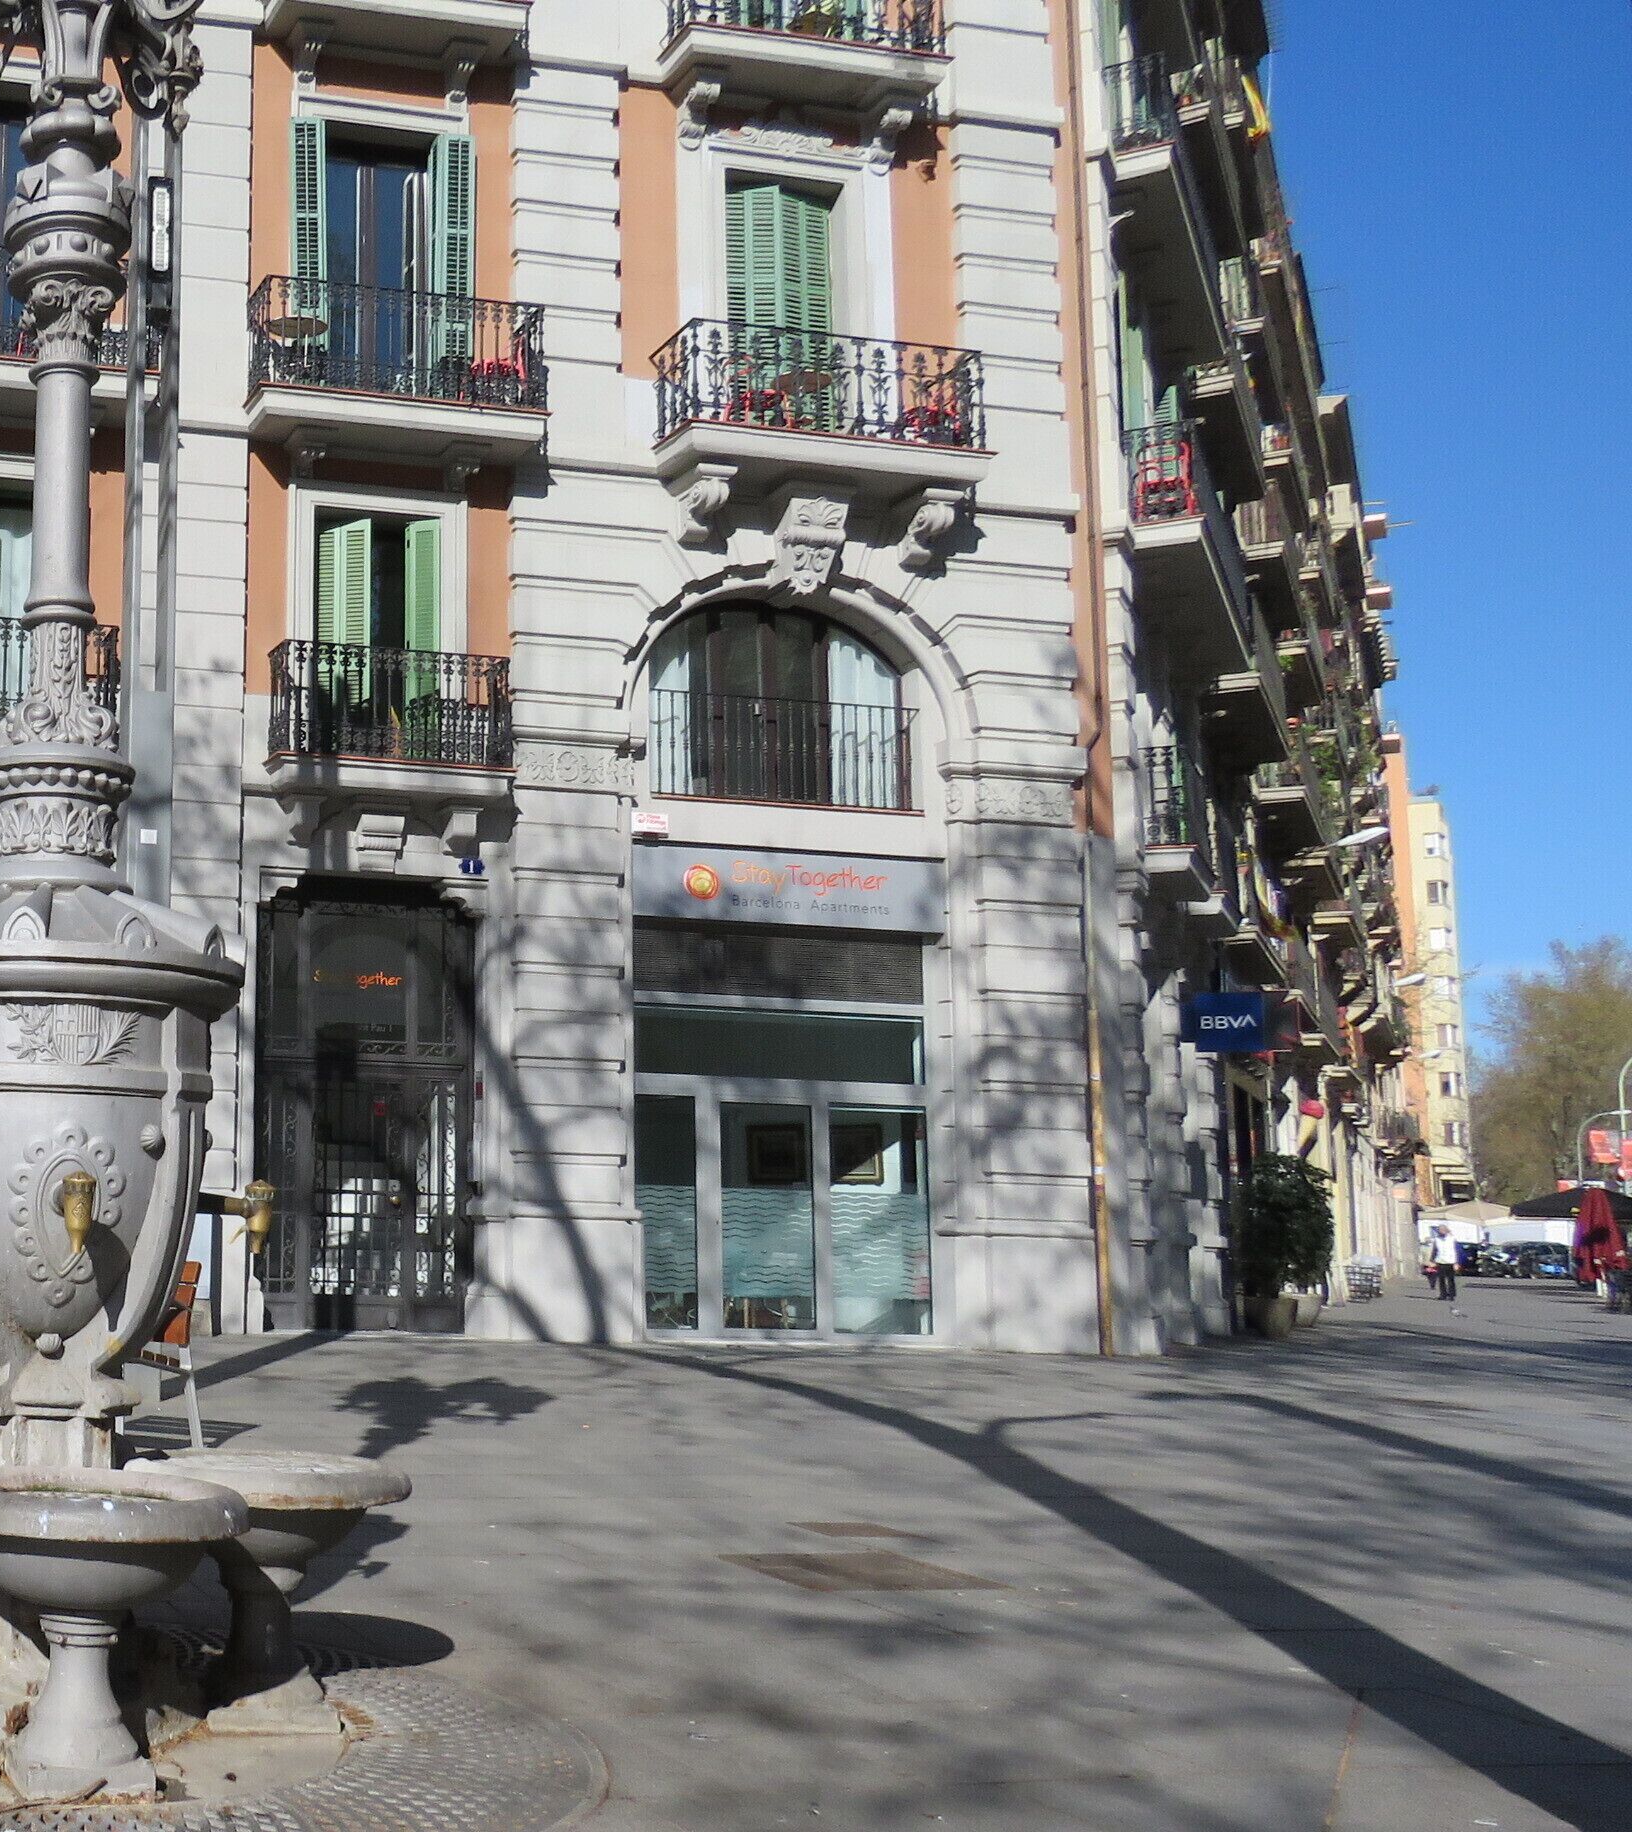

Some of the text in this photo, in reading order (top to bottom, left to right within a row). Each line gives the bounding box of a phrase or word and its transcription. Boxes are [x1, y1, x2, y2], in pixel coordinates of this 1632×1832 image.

[468, 860, 474, 873] 1
[732, 895, 890, 915] Barcelona Apartments
[1200, 1014, 1257, 1029] BBVA
